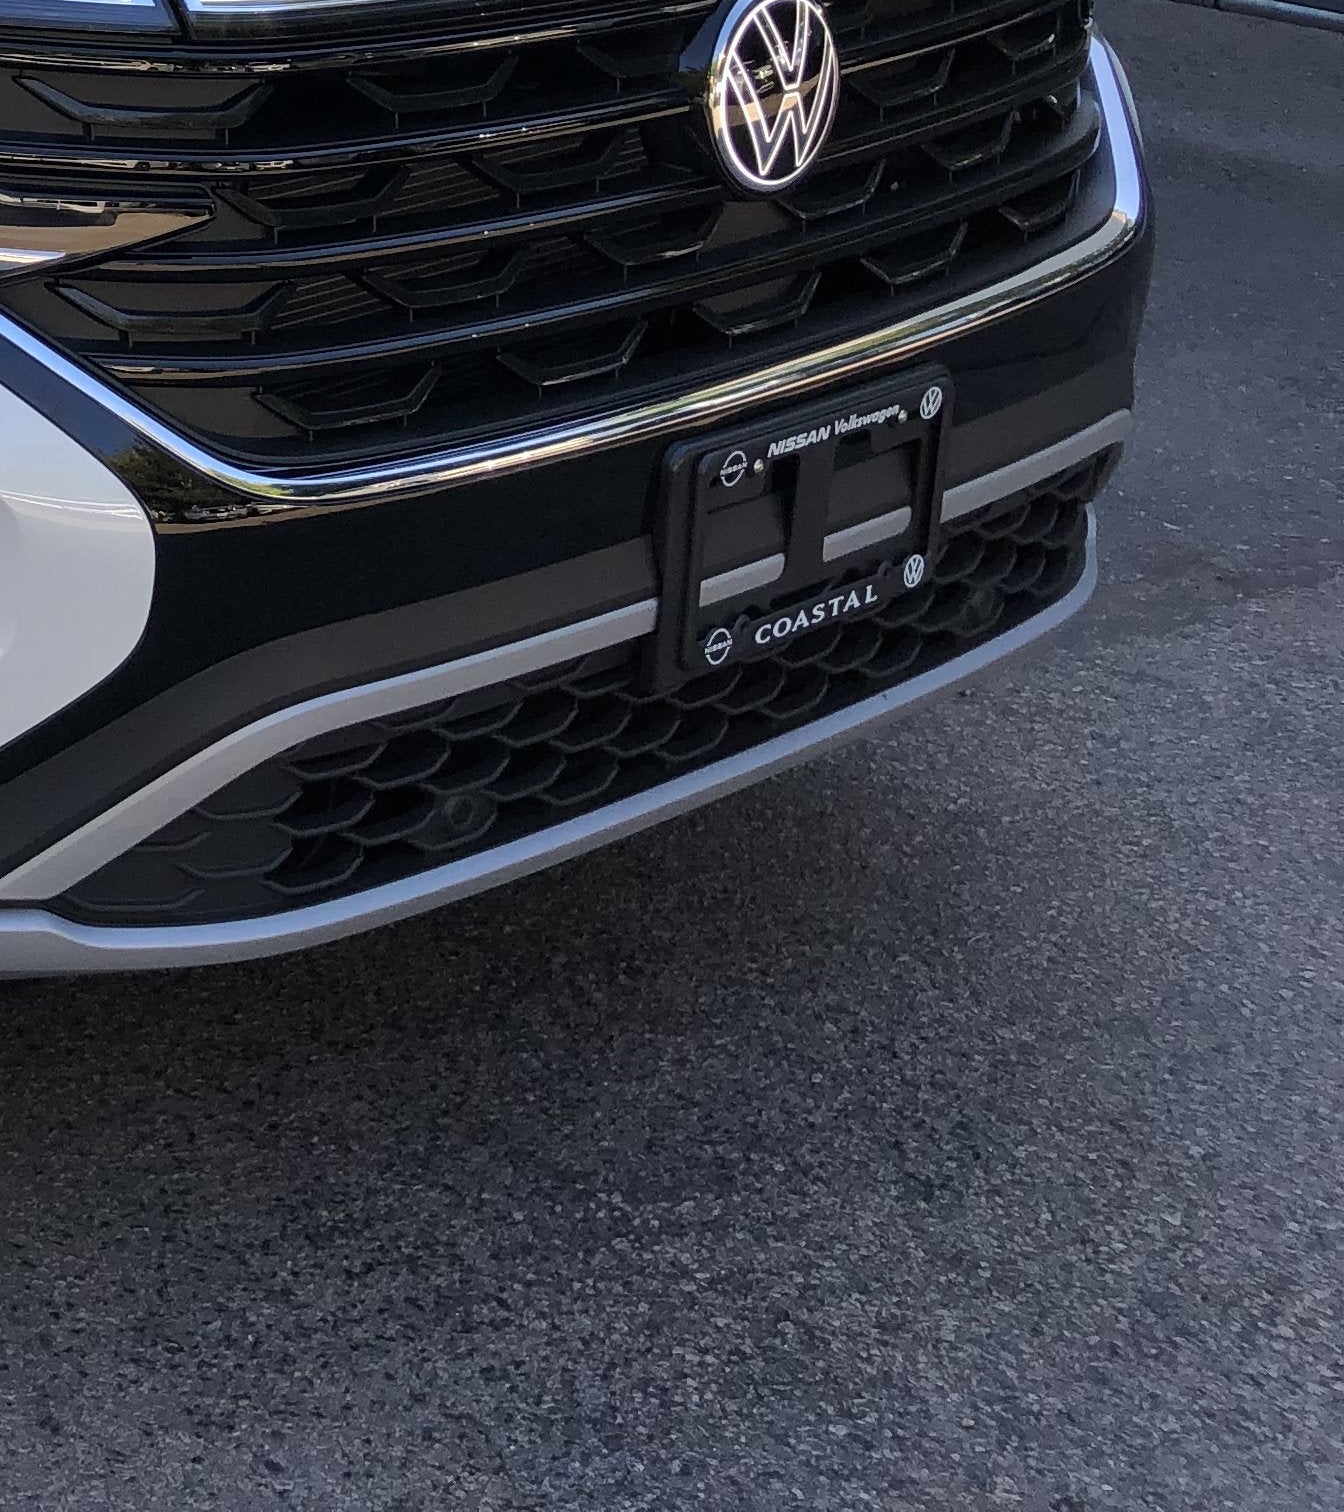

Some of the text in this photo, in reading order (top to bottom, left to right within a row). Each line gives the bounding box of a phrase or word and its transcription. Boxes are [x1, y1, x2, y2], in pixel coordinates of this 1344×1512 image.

[920, 386, 942, 419] VW
[767, 405, 900, 458] NISSAN Volkswagen
[903, 554, 924, 588] VW
[755, 584, 878, 645] COASTAL
